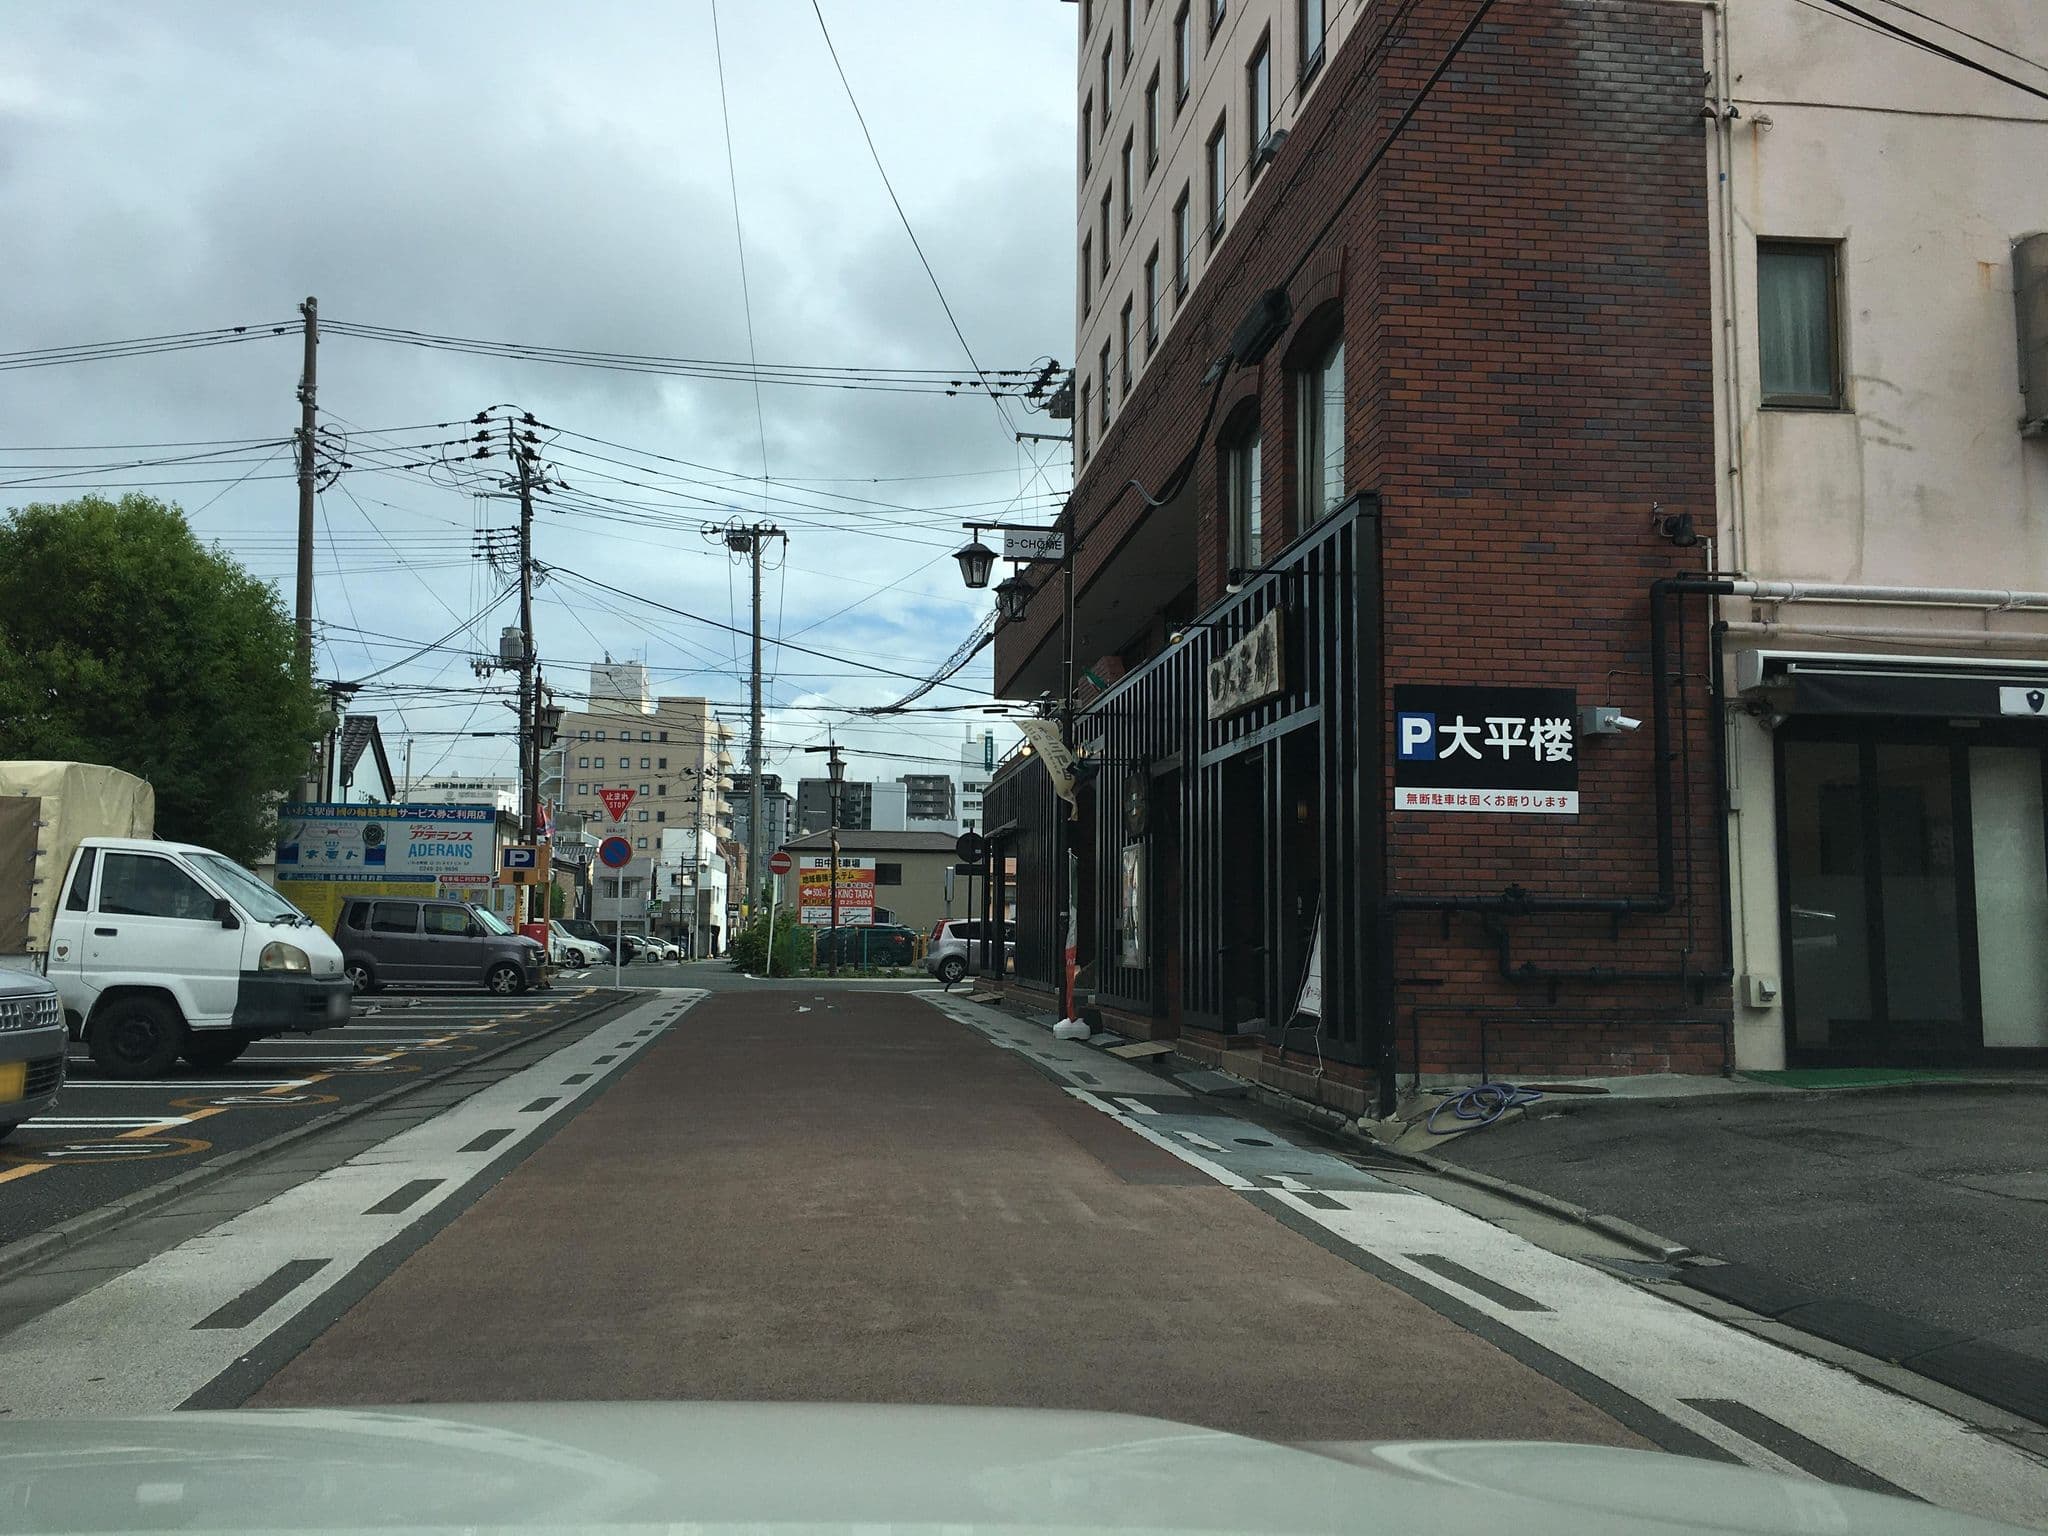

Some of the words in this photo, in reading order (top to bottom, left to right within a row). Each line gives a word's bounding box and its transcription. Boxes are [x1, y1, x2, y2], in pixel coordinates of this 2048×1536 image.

[1401, 717, 1431, 755] P
[1438, 715, 1573, 762] 大平楼
[606, 792, 629, 801] 止まれ
[1405, 792, 1569, 808] 無断駐車は固くお断りします
[408, 830, 473, 841] アデランス
[408, 842, 473, 859] ADERANS
[509, 850, 530, 866] P
